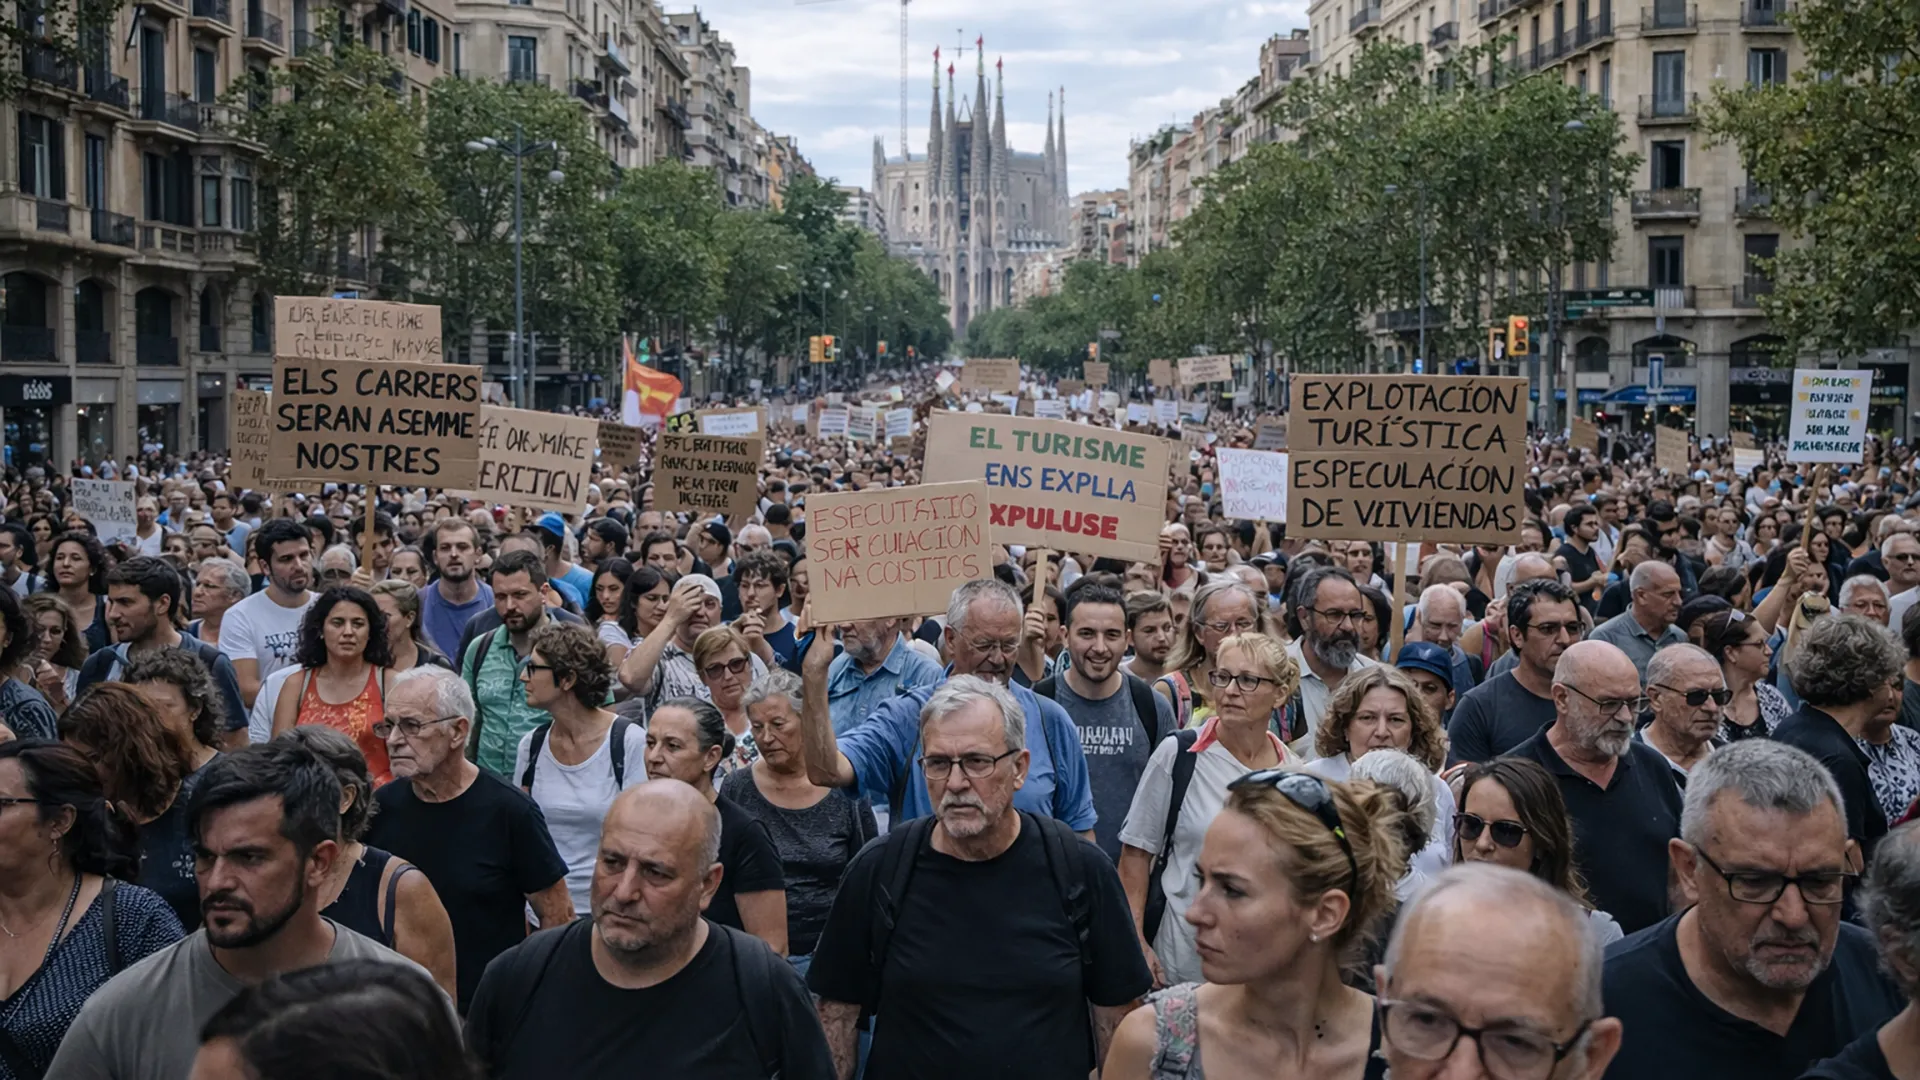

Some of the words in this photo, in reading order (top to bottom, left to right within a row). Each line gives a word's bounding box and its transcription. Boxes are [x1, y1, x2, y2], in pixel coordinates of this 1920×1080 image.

[283, 367, 338, 396] ELS
[356, 368, 478, 402] CARRERS
[276, 403, 372, 432] SERAN
[377, 408, 475, 438] ASEMME
[296, 442, 441, 475] NOSTRES
[969, 426, 1003, 450] EL
[1012, 430, 1147, 468] TURISME
[985, 463, 1033, 488] ENS
[1041, 467, 1137, 503] EXPLLA
[1301, 497, 1344, 527] DE
[824, 565, 861, 592] NA
